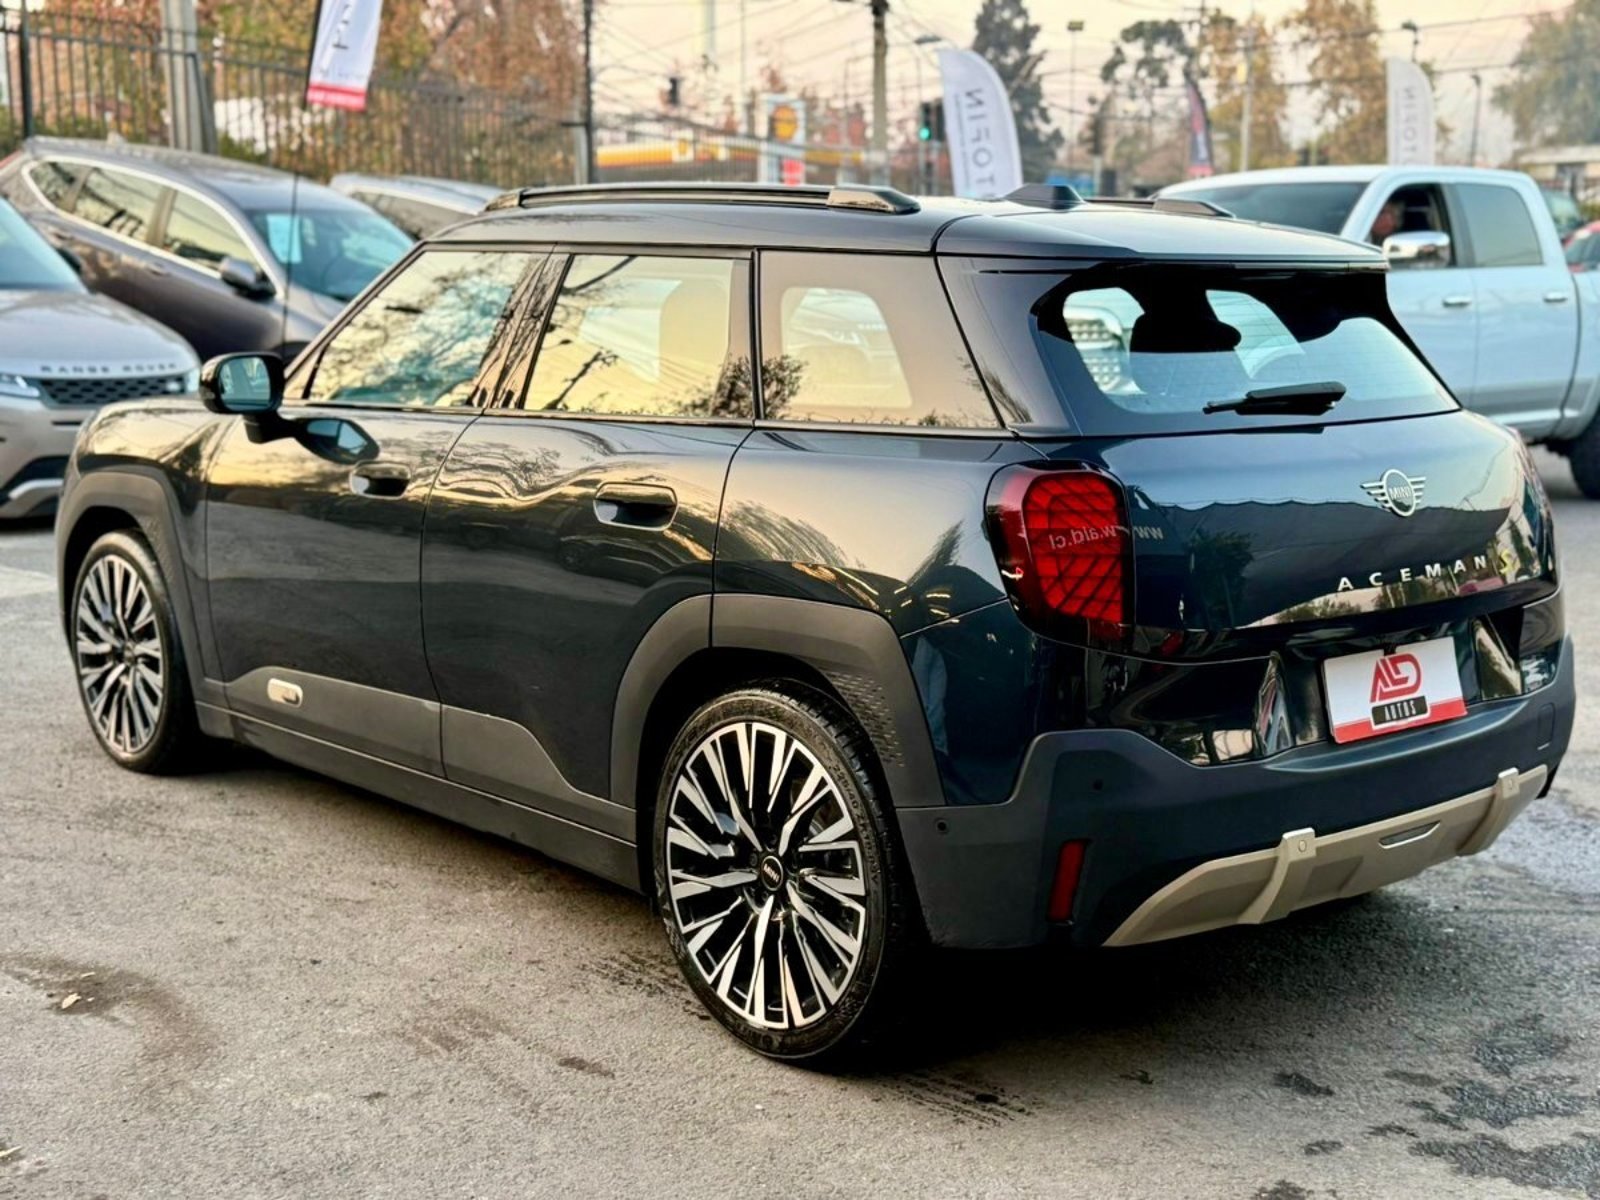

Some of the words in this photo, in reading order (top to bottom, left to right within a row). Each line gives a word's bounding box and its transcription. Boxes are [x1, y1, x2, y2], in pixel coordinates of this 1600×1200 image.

[40, 365, 110, 374] RANGE
[122, 363, 177, 372] ROVER
[1388, 485, 1411, 501] MINI
[1336, 554, 1489, 592] ACEMAN
[1369, 652, 1423, 704] ALD
[1384, 699, 1418, 721] AUTOS
